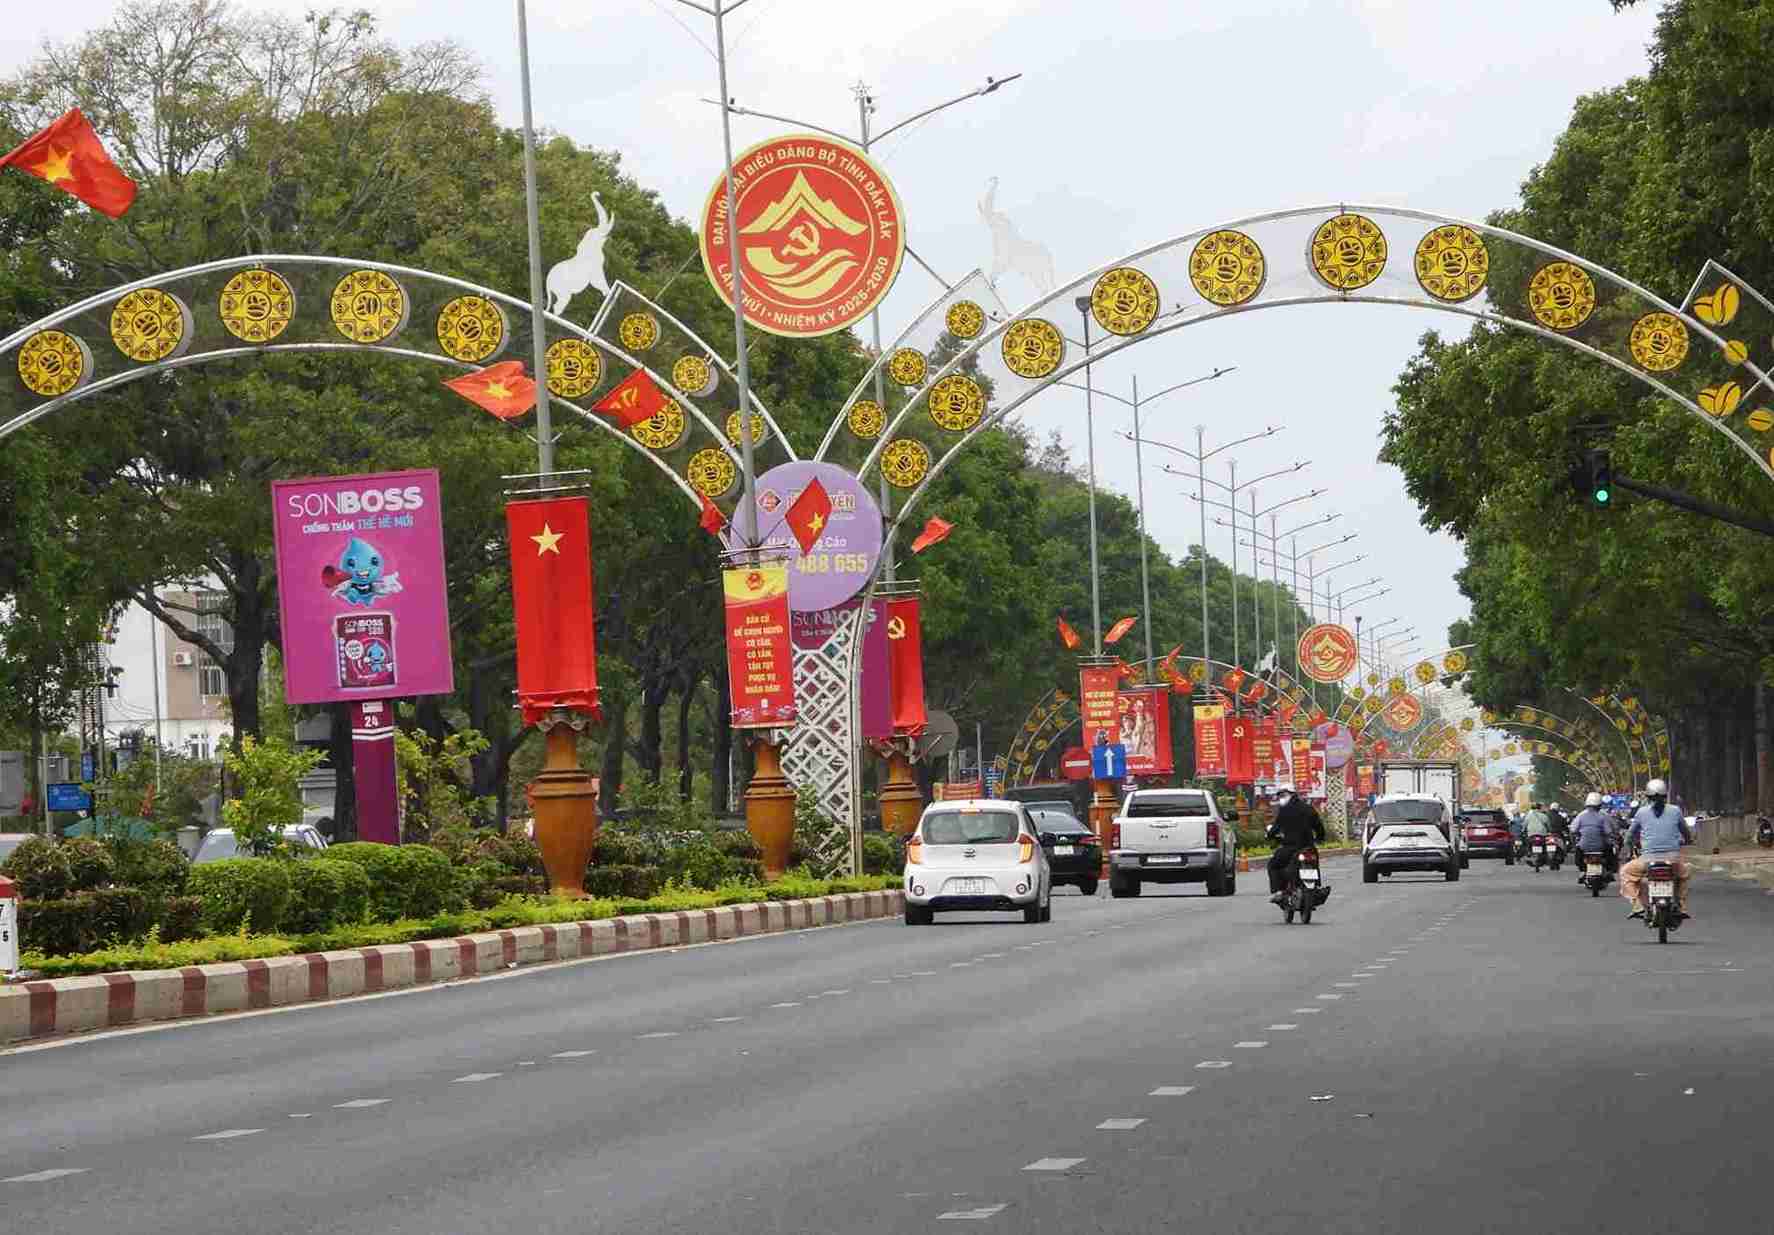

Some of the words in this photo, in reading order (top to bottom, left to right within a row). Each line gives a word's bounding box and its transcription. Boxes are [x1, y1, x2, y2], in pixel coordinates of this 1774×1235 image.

[712, 221, 727, 246] ĐẠI
[744, 152, 775, 177] BIỂU
[777, 143, 815, 160] ĐẢNG
[818, 148, 837, 165] BỘ
[839, 155, 868, 183] TỈNH
[774, 310, 816, 330] NHIỆM
[818, 307, 836, 325] KỲ
[838, 256, 889, 316] 2025-2030
[288, 486, 424, 518] SONBOSS
